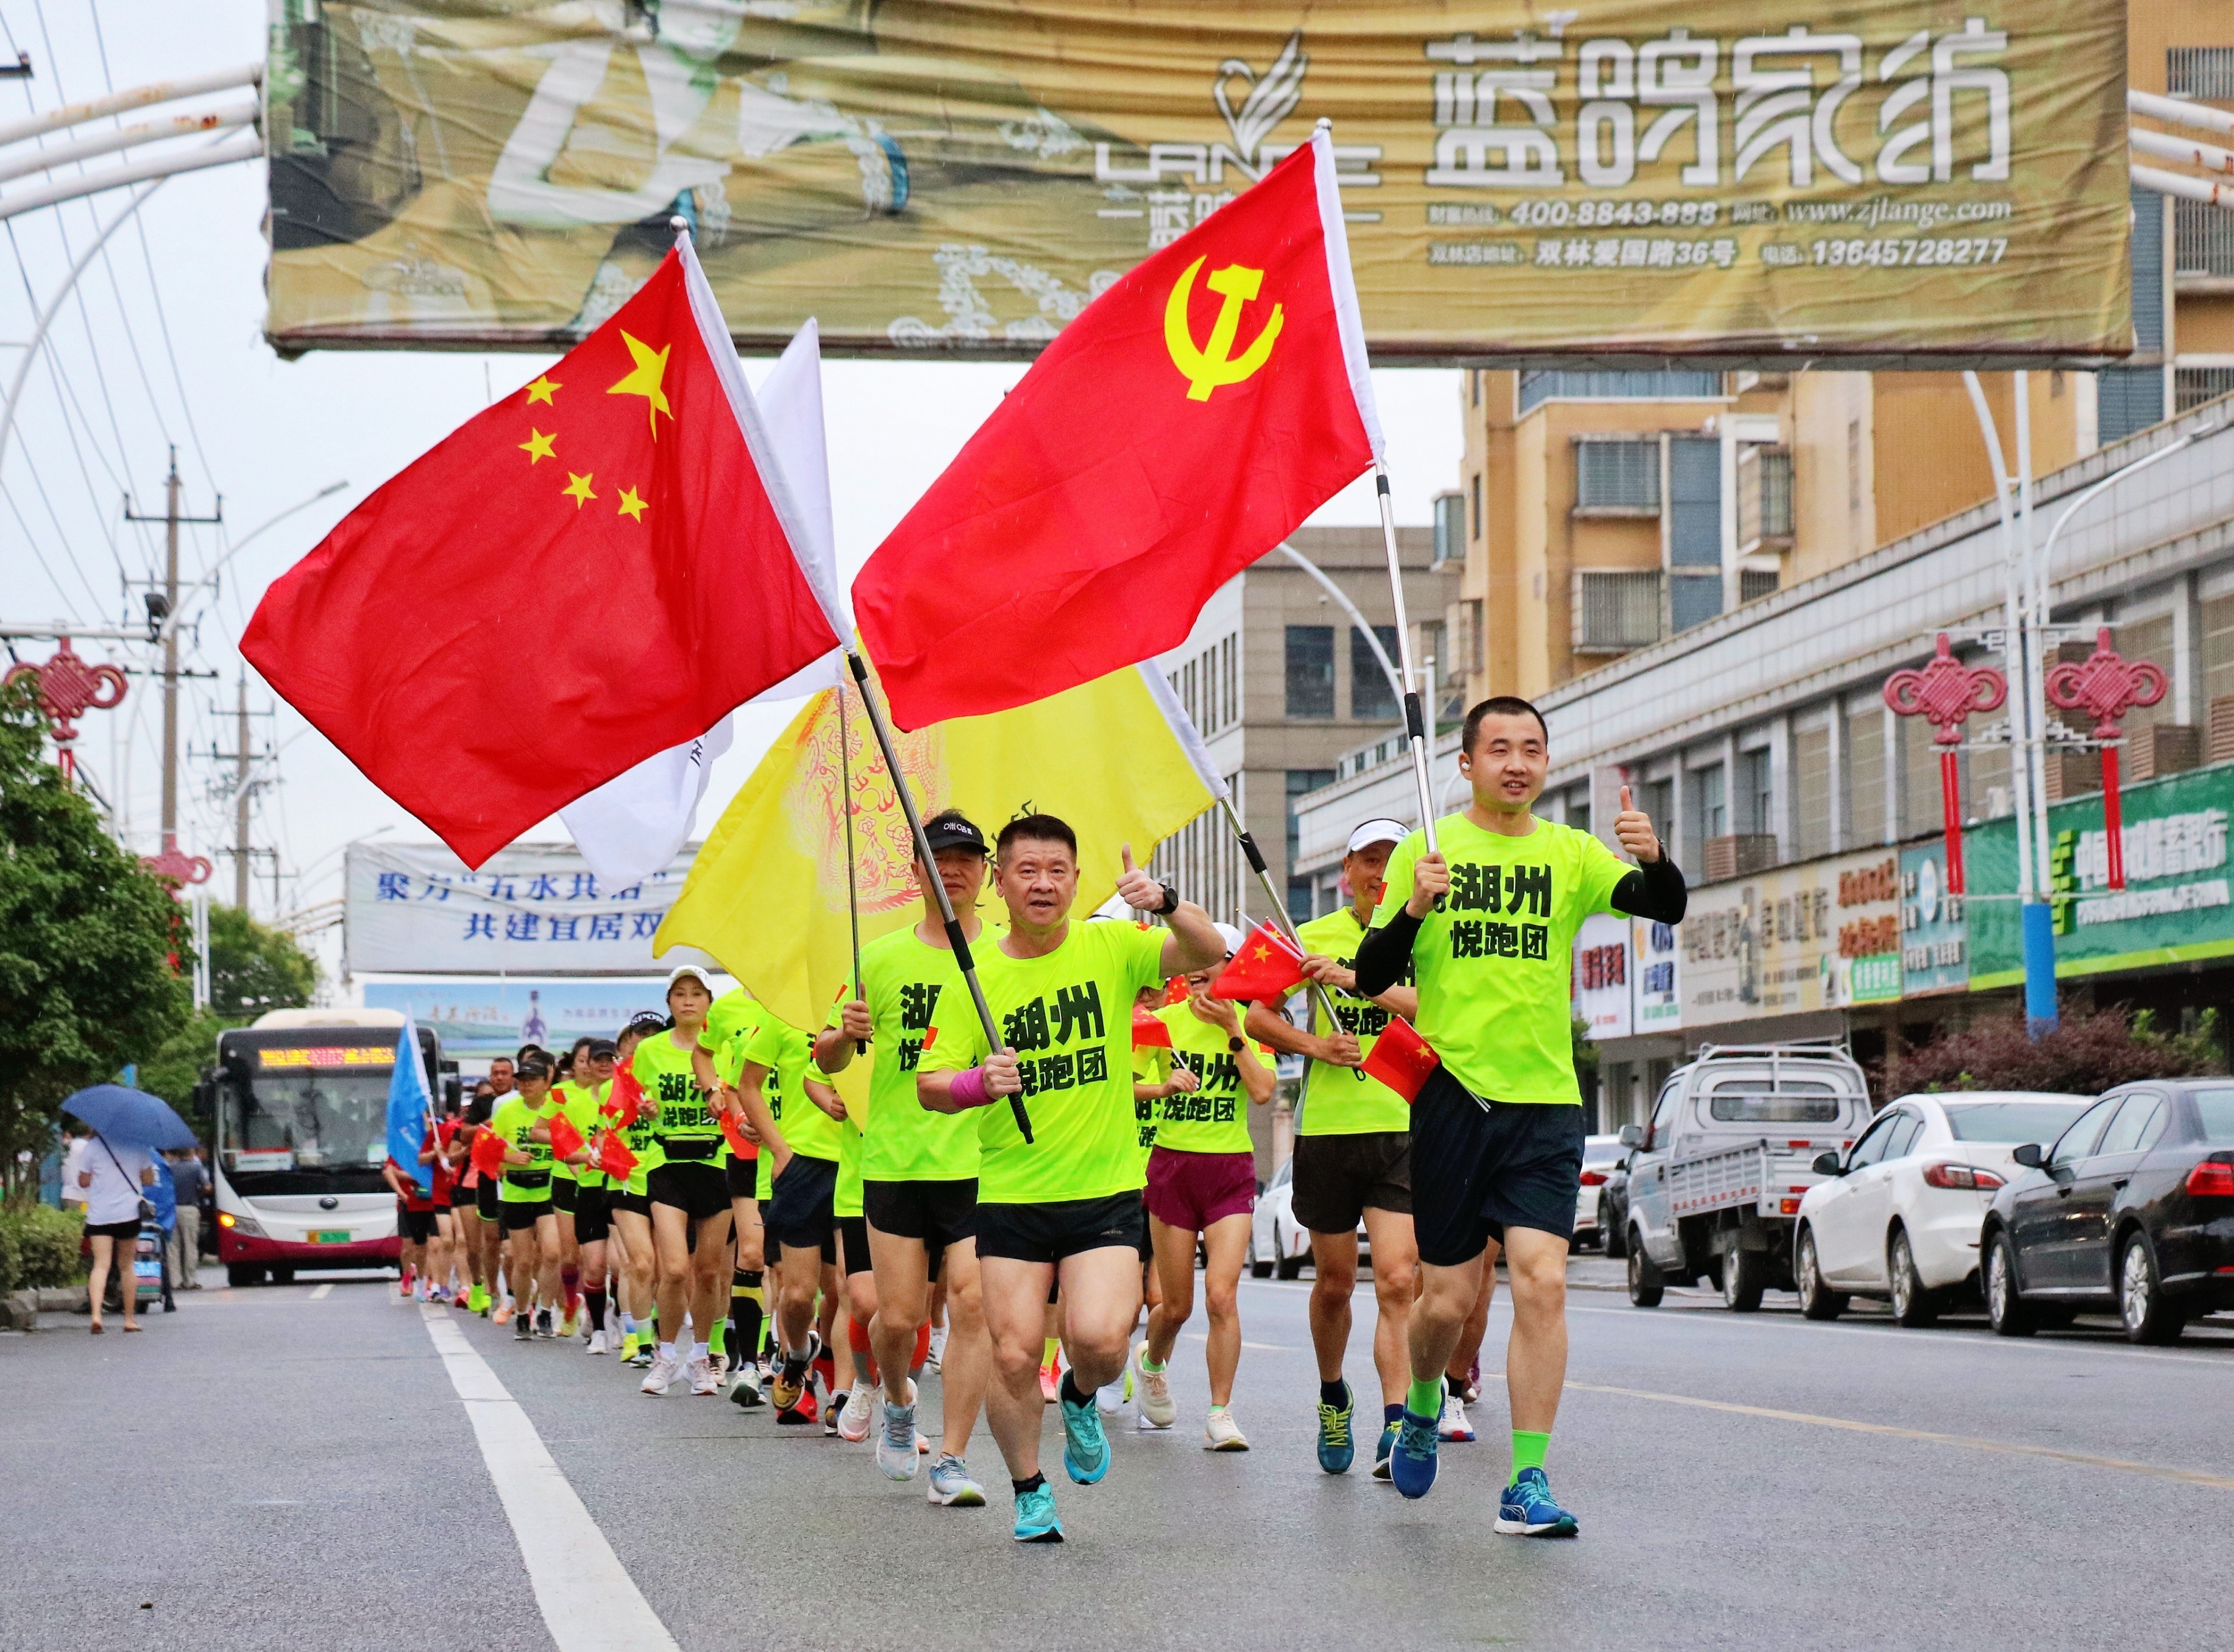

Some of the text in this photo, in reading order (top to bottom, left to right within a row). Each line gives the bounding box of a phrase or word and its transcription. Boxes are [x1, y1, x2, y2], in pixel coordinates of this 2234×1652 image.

[1536, 239, 1736, 266] 双林爱国路36号
[1813, 239, 2009, 266] 13645728277
[1450, 863, 1552, 917] 湖州
[1450, 920, 1547, 961] 悦跑团
[1003, 980, 1105, 1053] 湖州
[1164, 1095, 1236, 1122] 悦跑团
